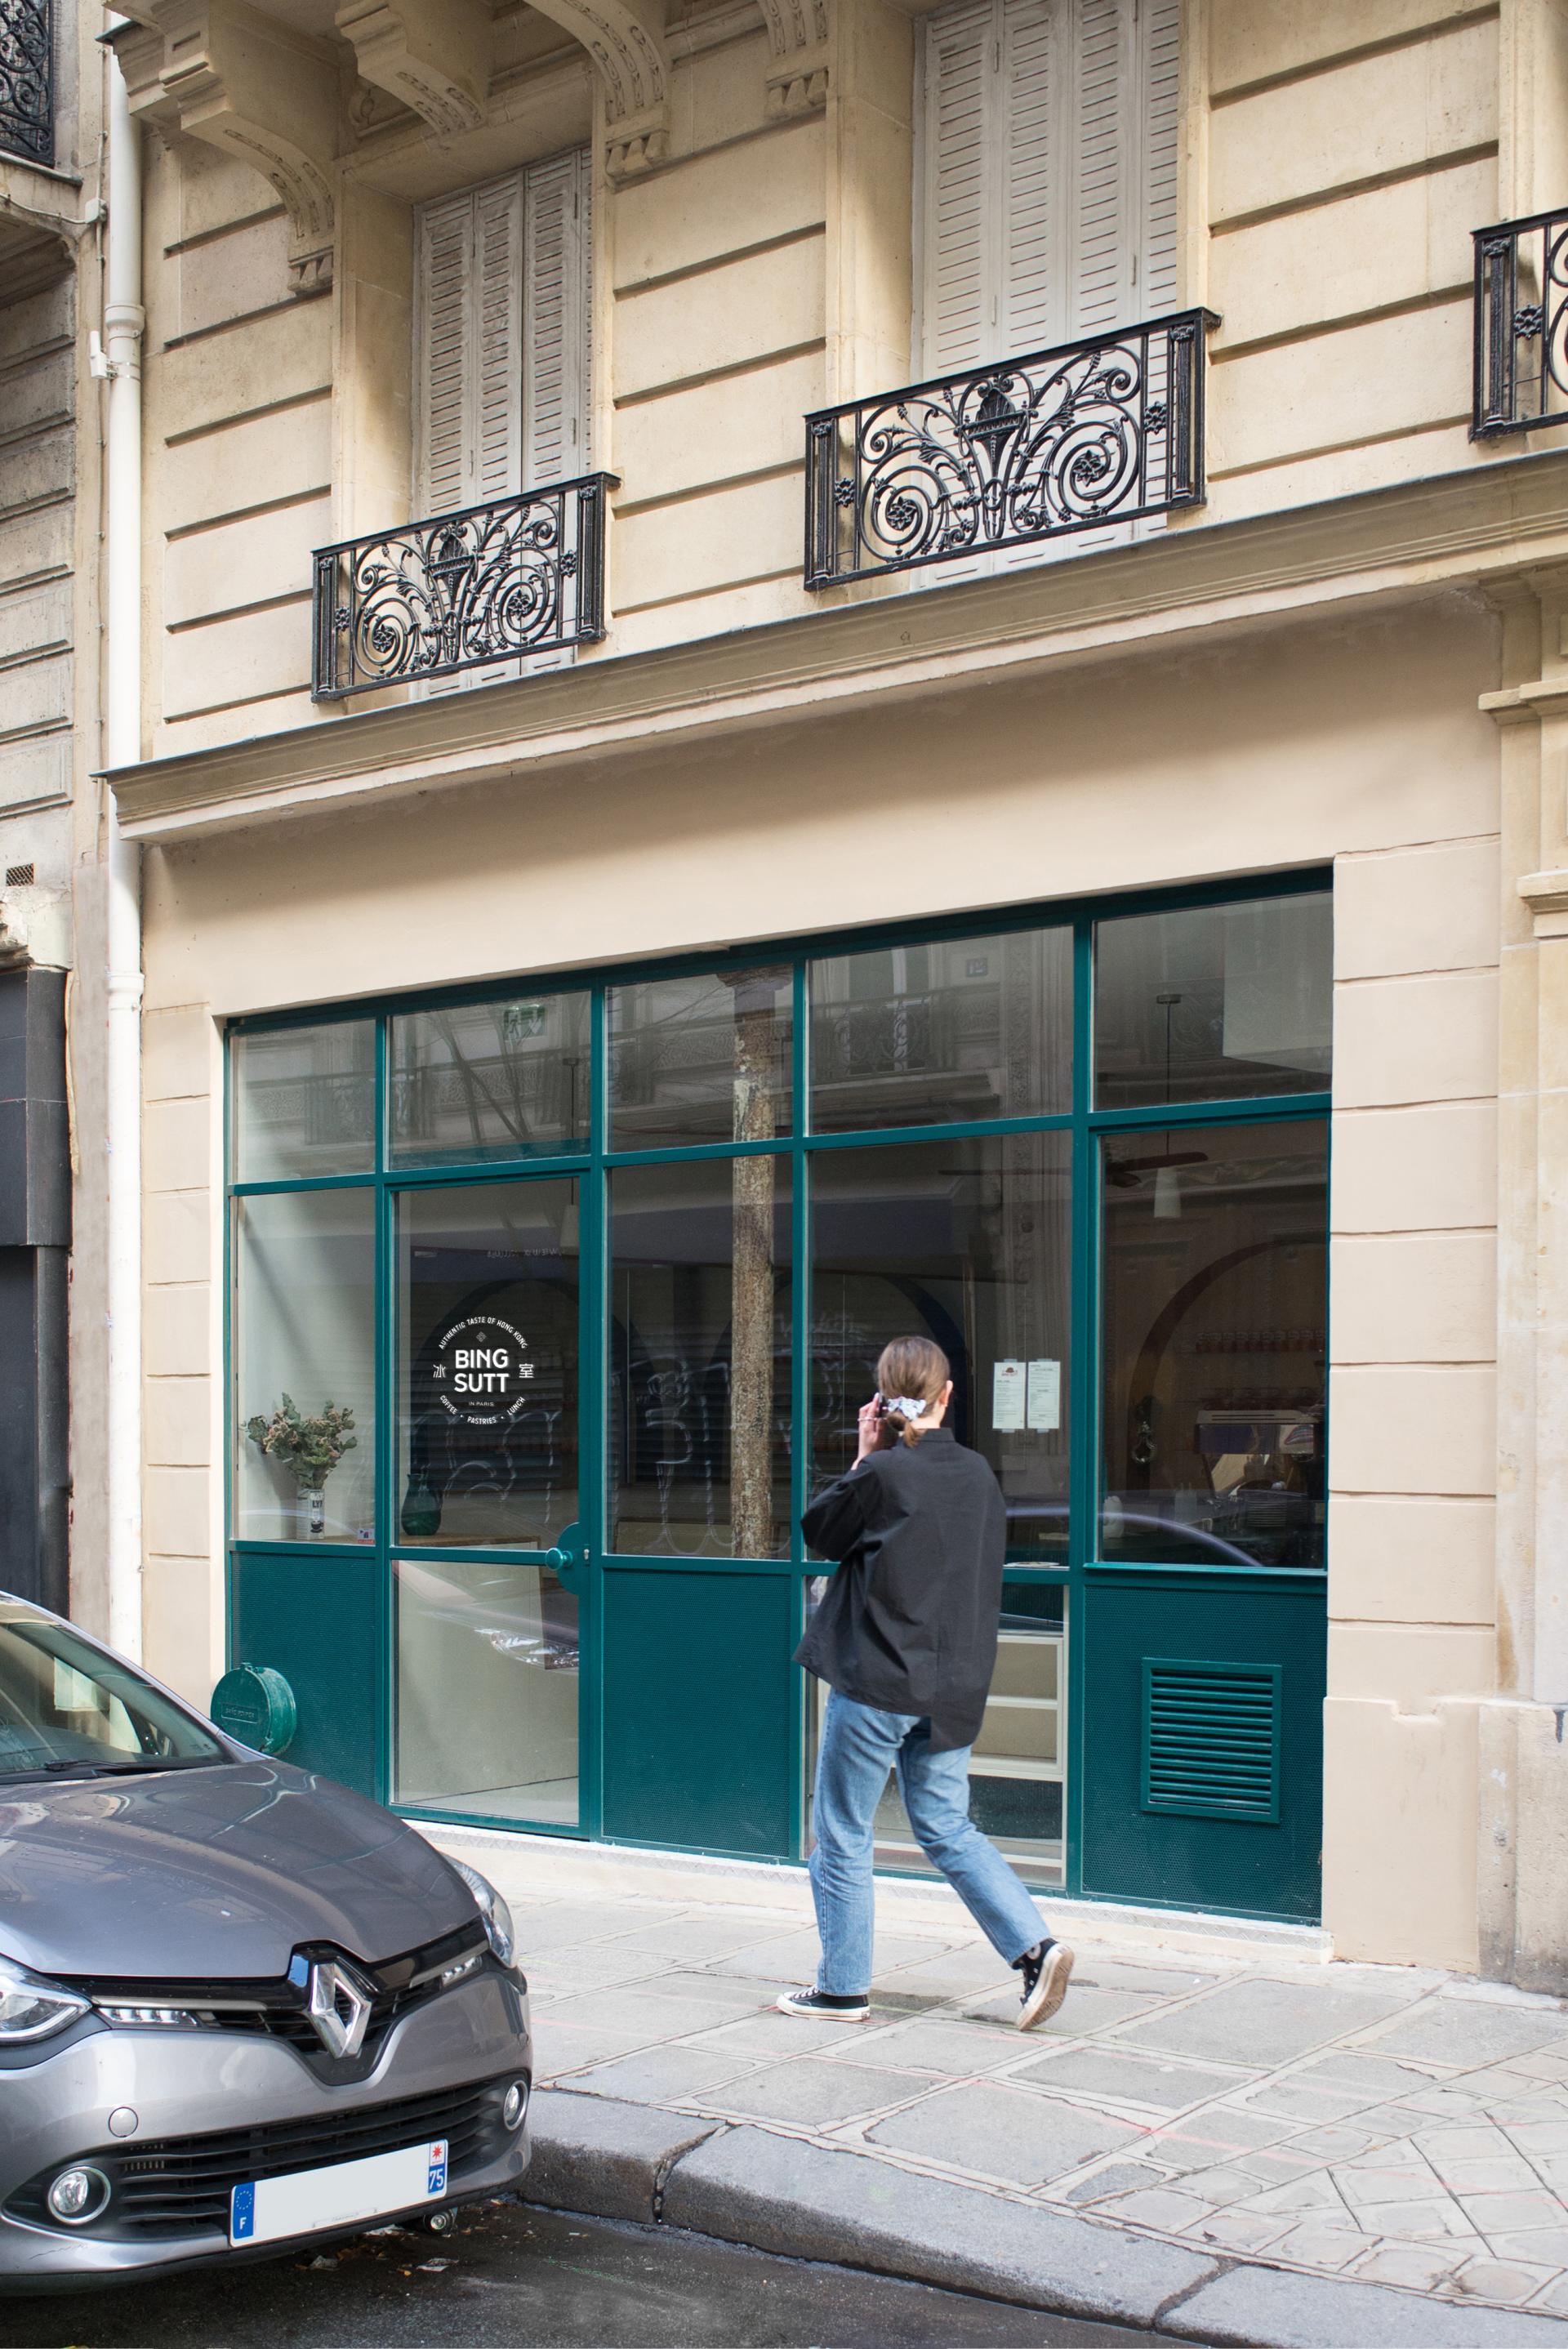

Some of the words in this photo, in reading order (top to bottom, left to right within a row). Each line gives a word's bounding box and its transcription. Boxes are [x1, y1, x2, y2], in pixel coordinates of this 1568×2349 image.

[439, 1322, 466, 1350] AUTHENTIC
[466, 1317, 485, 1326] TASTE
[497, 1319, 514, 1333] HONG
[512, 1331, 529, 1349] KONG
[455, 1348, 509, 1369] BING
[519, 1363, 534, 1379] 室
[454, 1373, 510, 1393] SUTT
[440, 1395, 457, 1415] COFFEE
[467, 1416, 497, 1425] PASTRIES
[506, 1396, 527, 1415] LUNCH
[429, 2168, 443, 2190] 75
[239, 2217, 247, 2231] F
